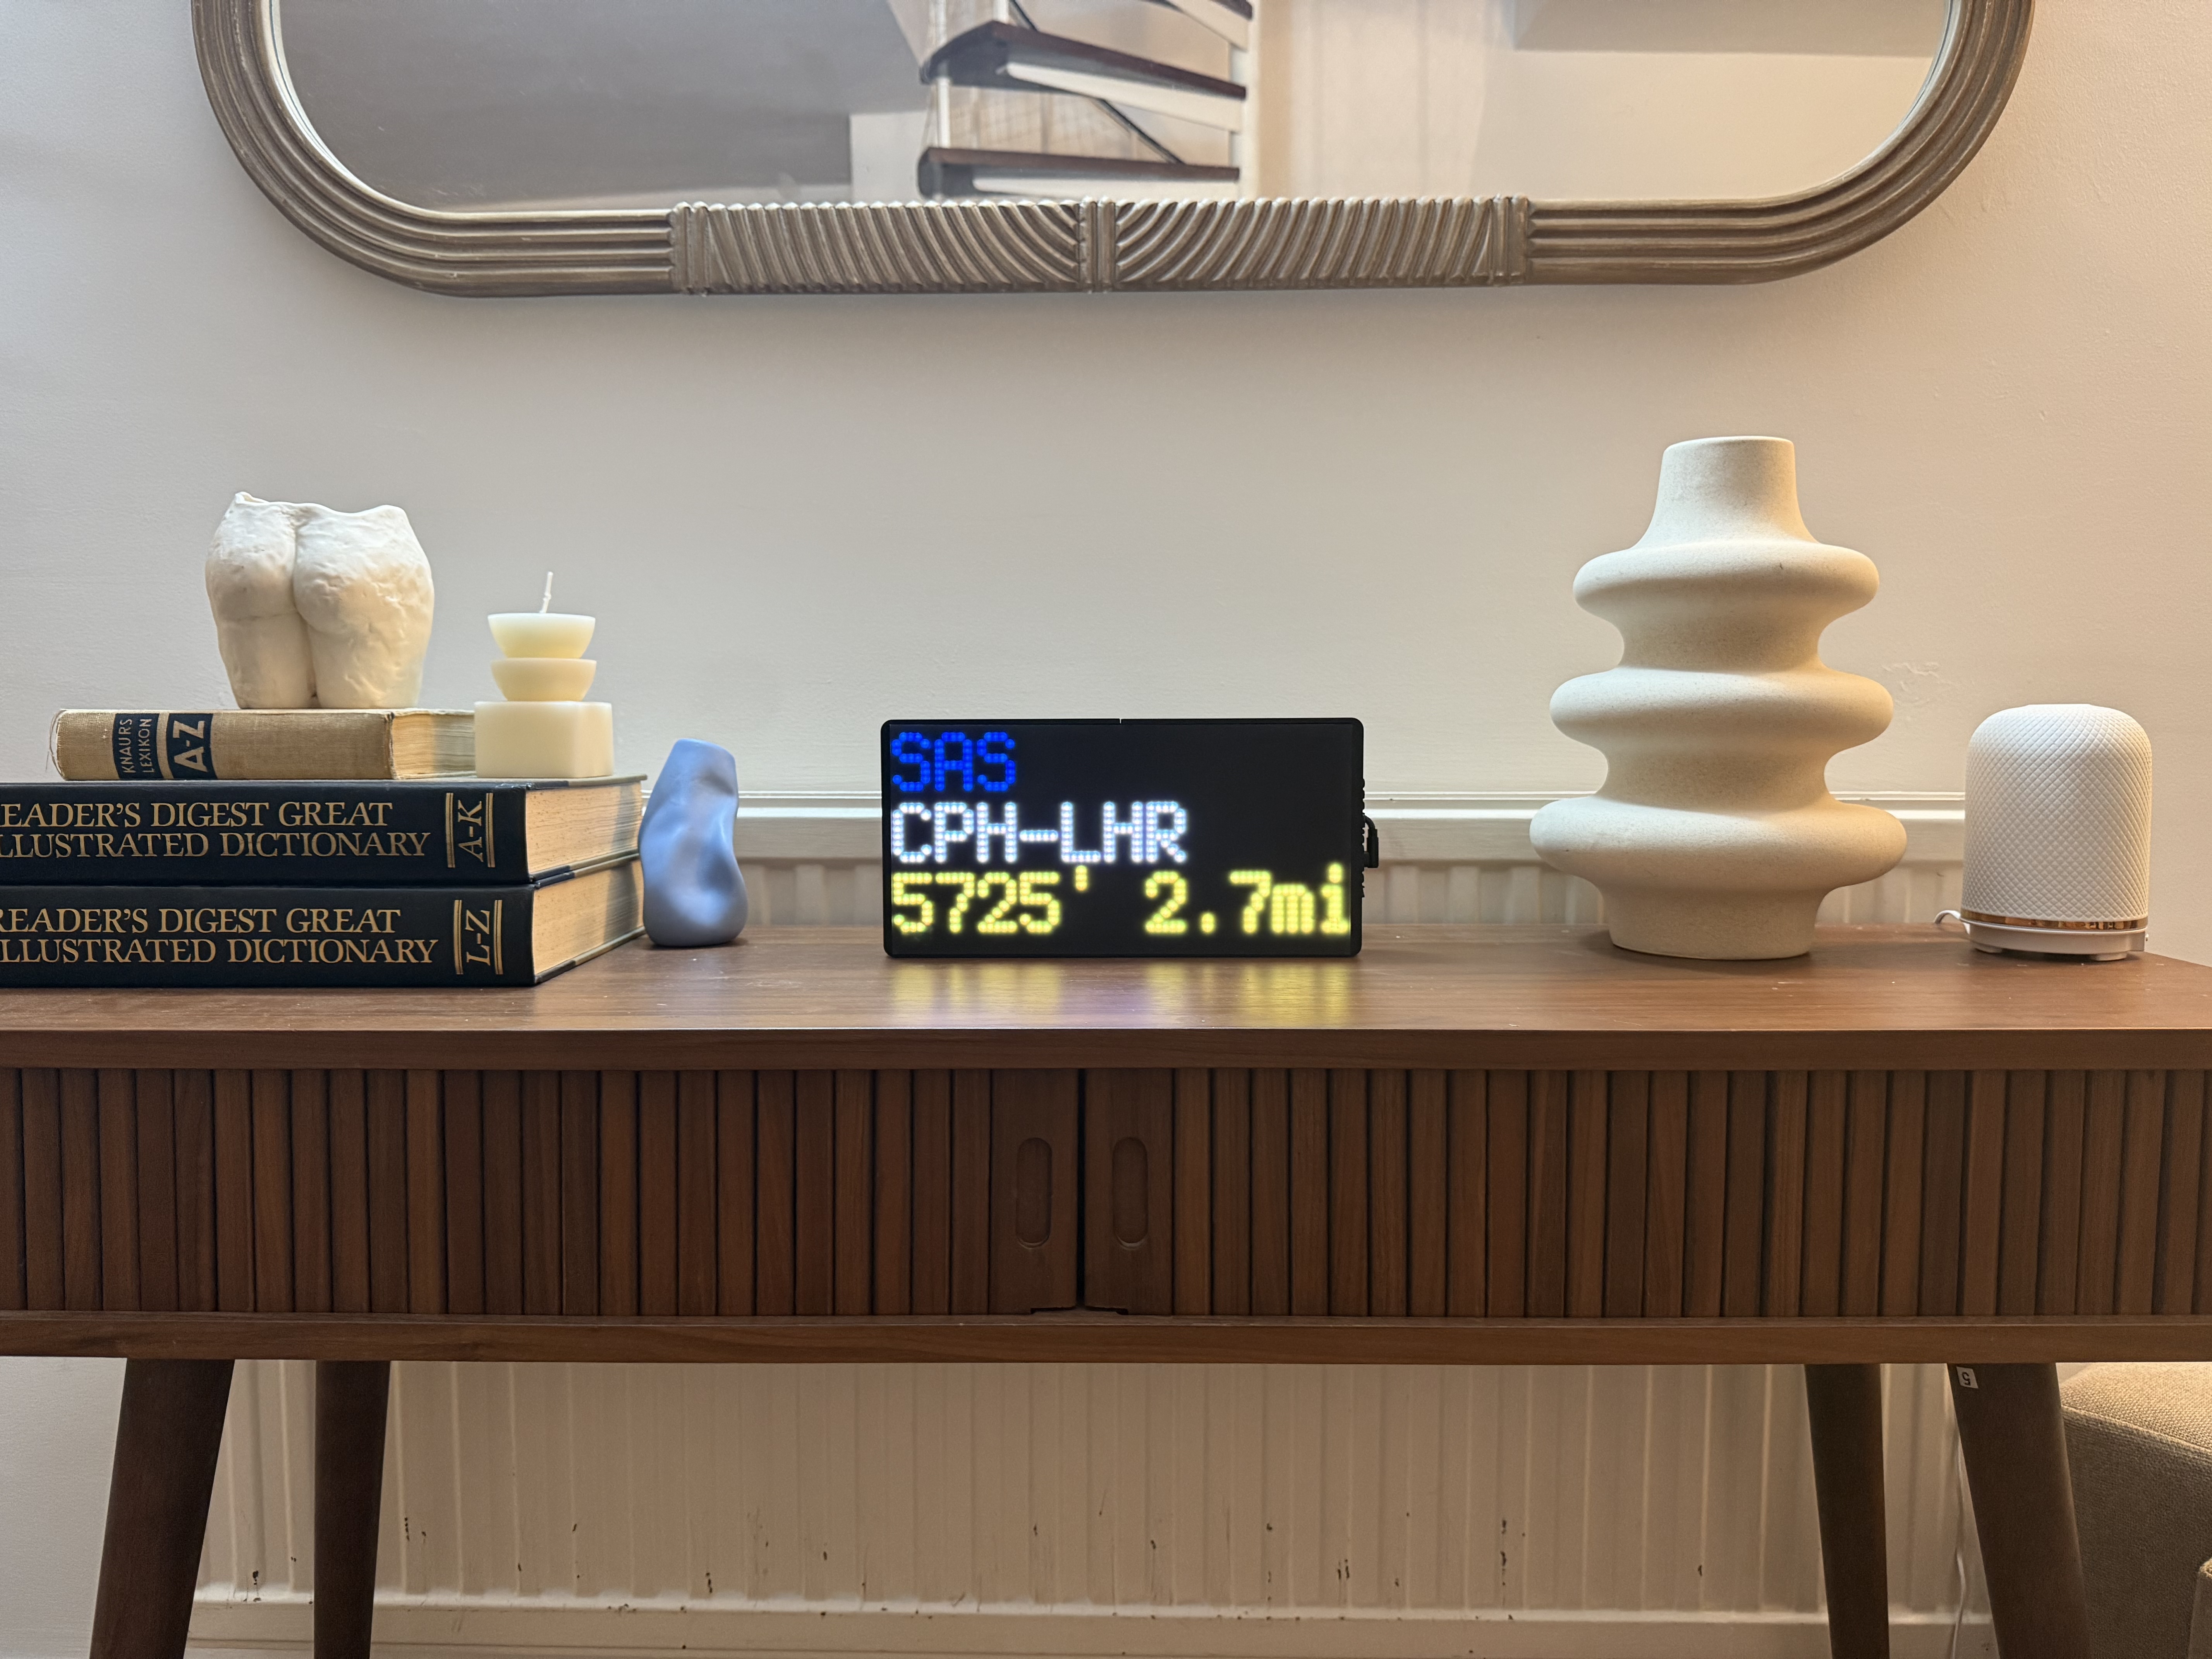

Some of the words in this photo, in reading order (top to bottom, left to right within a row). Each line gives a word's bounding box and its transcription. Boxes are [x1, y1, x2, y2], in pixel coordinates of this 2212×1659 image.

[118, 718, 136, 773] KNAURS
[138, 718, 155, 773] LEXIKON
[172, 720, 209, 773] A-Z
[891, 732, 1017, 793] SAS
[0, 803, 141, 828] EADER'S
[151, 802, 270, 827] DIGEST
[279, 802, 393, 827] GREAT
[458, 800, 483, 862] A-K
[891, 801, 1187, 864] CPH-LHR
[0, 833, 209, 858] LLUSTRATED
[220, 833, 431, 857] DICTIONARY
[159, 908, 277, 933] DIGEST
[287, 908, 401, 933] GREAT
[892, 865, 1089, 934] 5725'
[1144, 863, 1350, 935] 2.7mi
[0, 939, 216, 963] LLUSTRATED
[227, 939, 439, 963] DICTIONARY
[465, 910, 491, 966] L-Z
